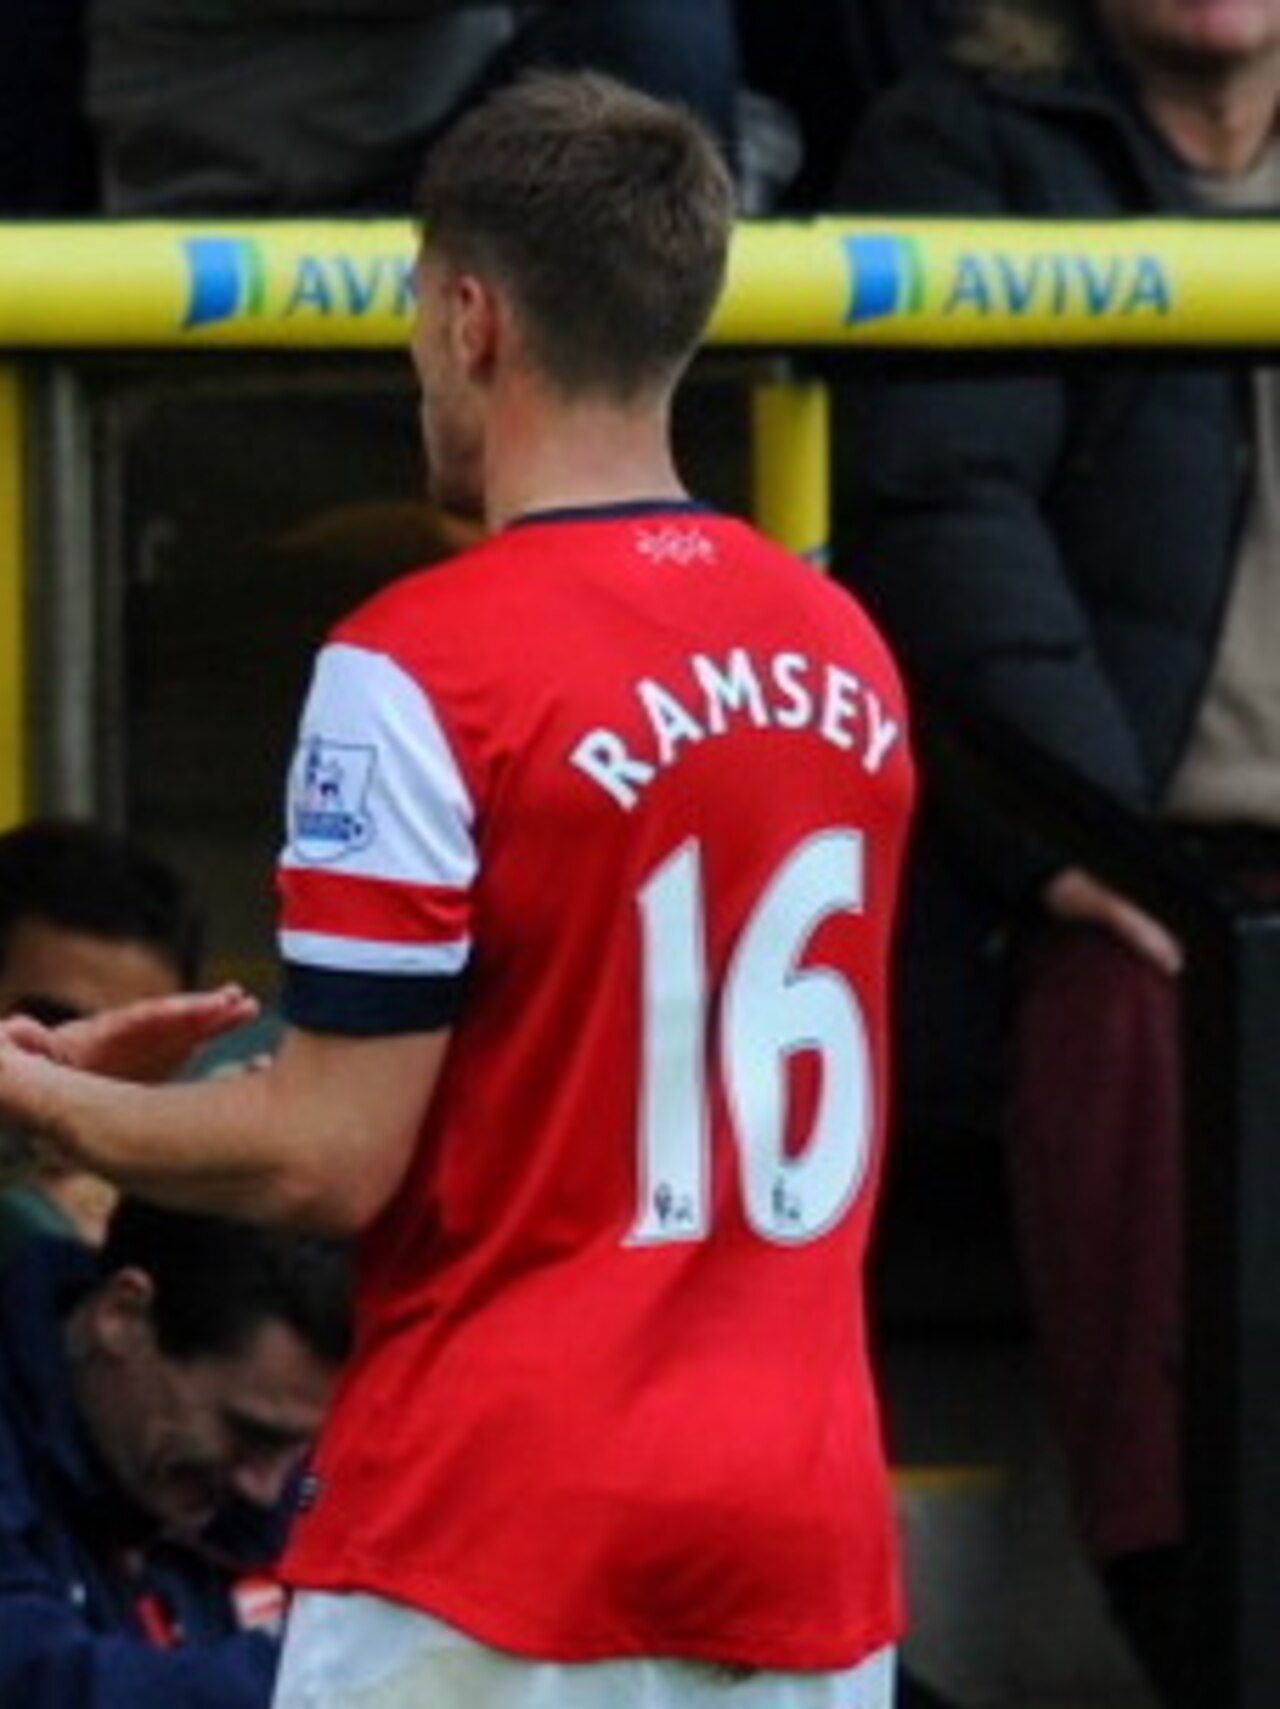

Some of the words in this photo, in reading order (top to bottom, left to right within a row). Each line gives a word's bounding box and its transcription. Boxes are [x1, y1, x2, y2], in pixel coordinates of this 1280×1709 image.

[281, 255, 418, 317] AVI
[940, 253, 1170, 317] AVIVA
[568, 647, 898, 812] RAMSEY
[621, 826, 875, 1247] 16
